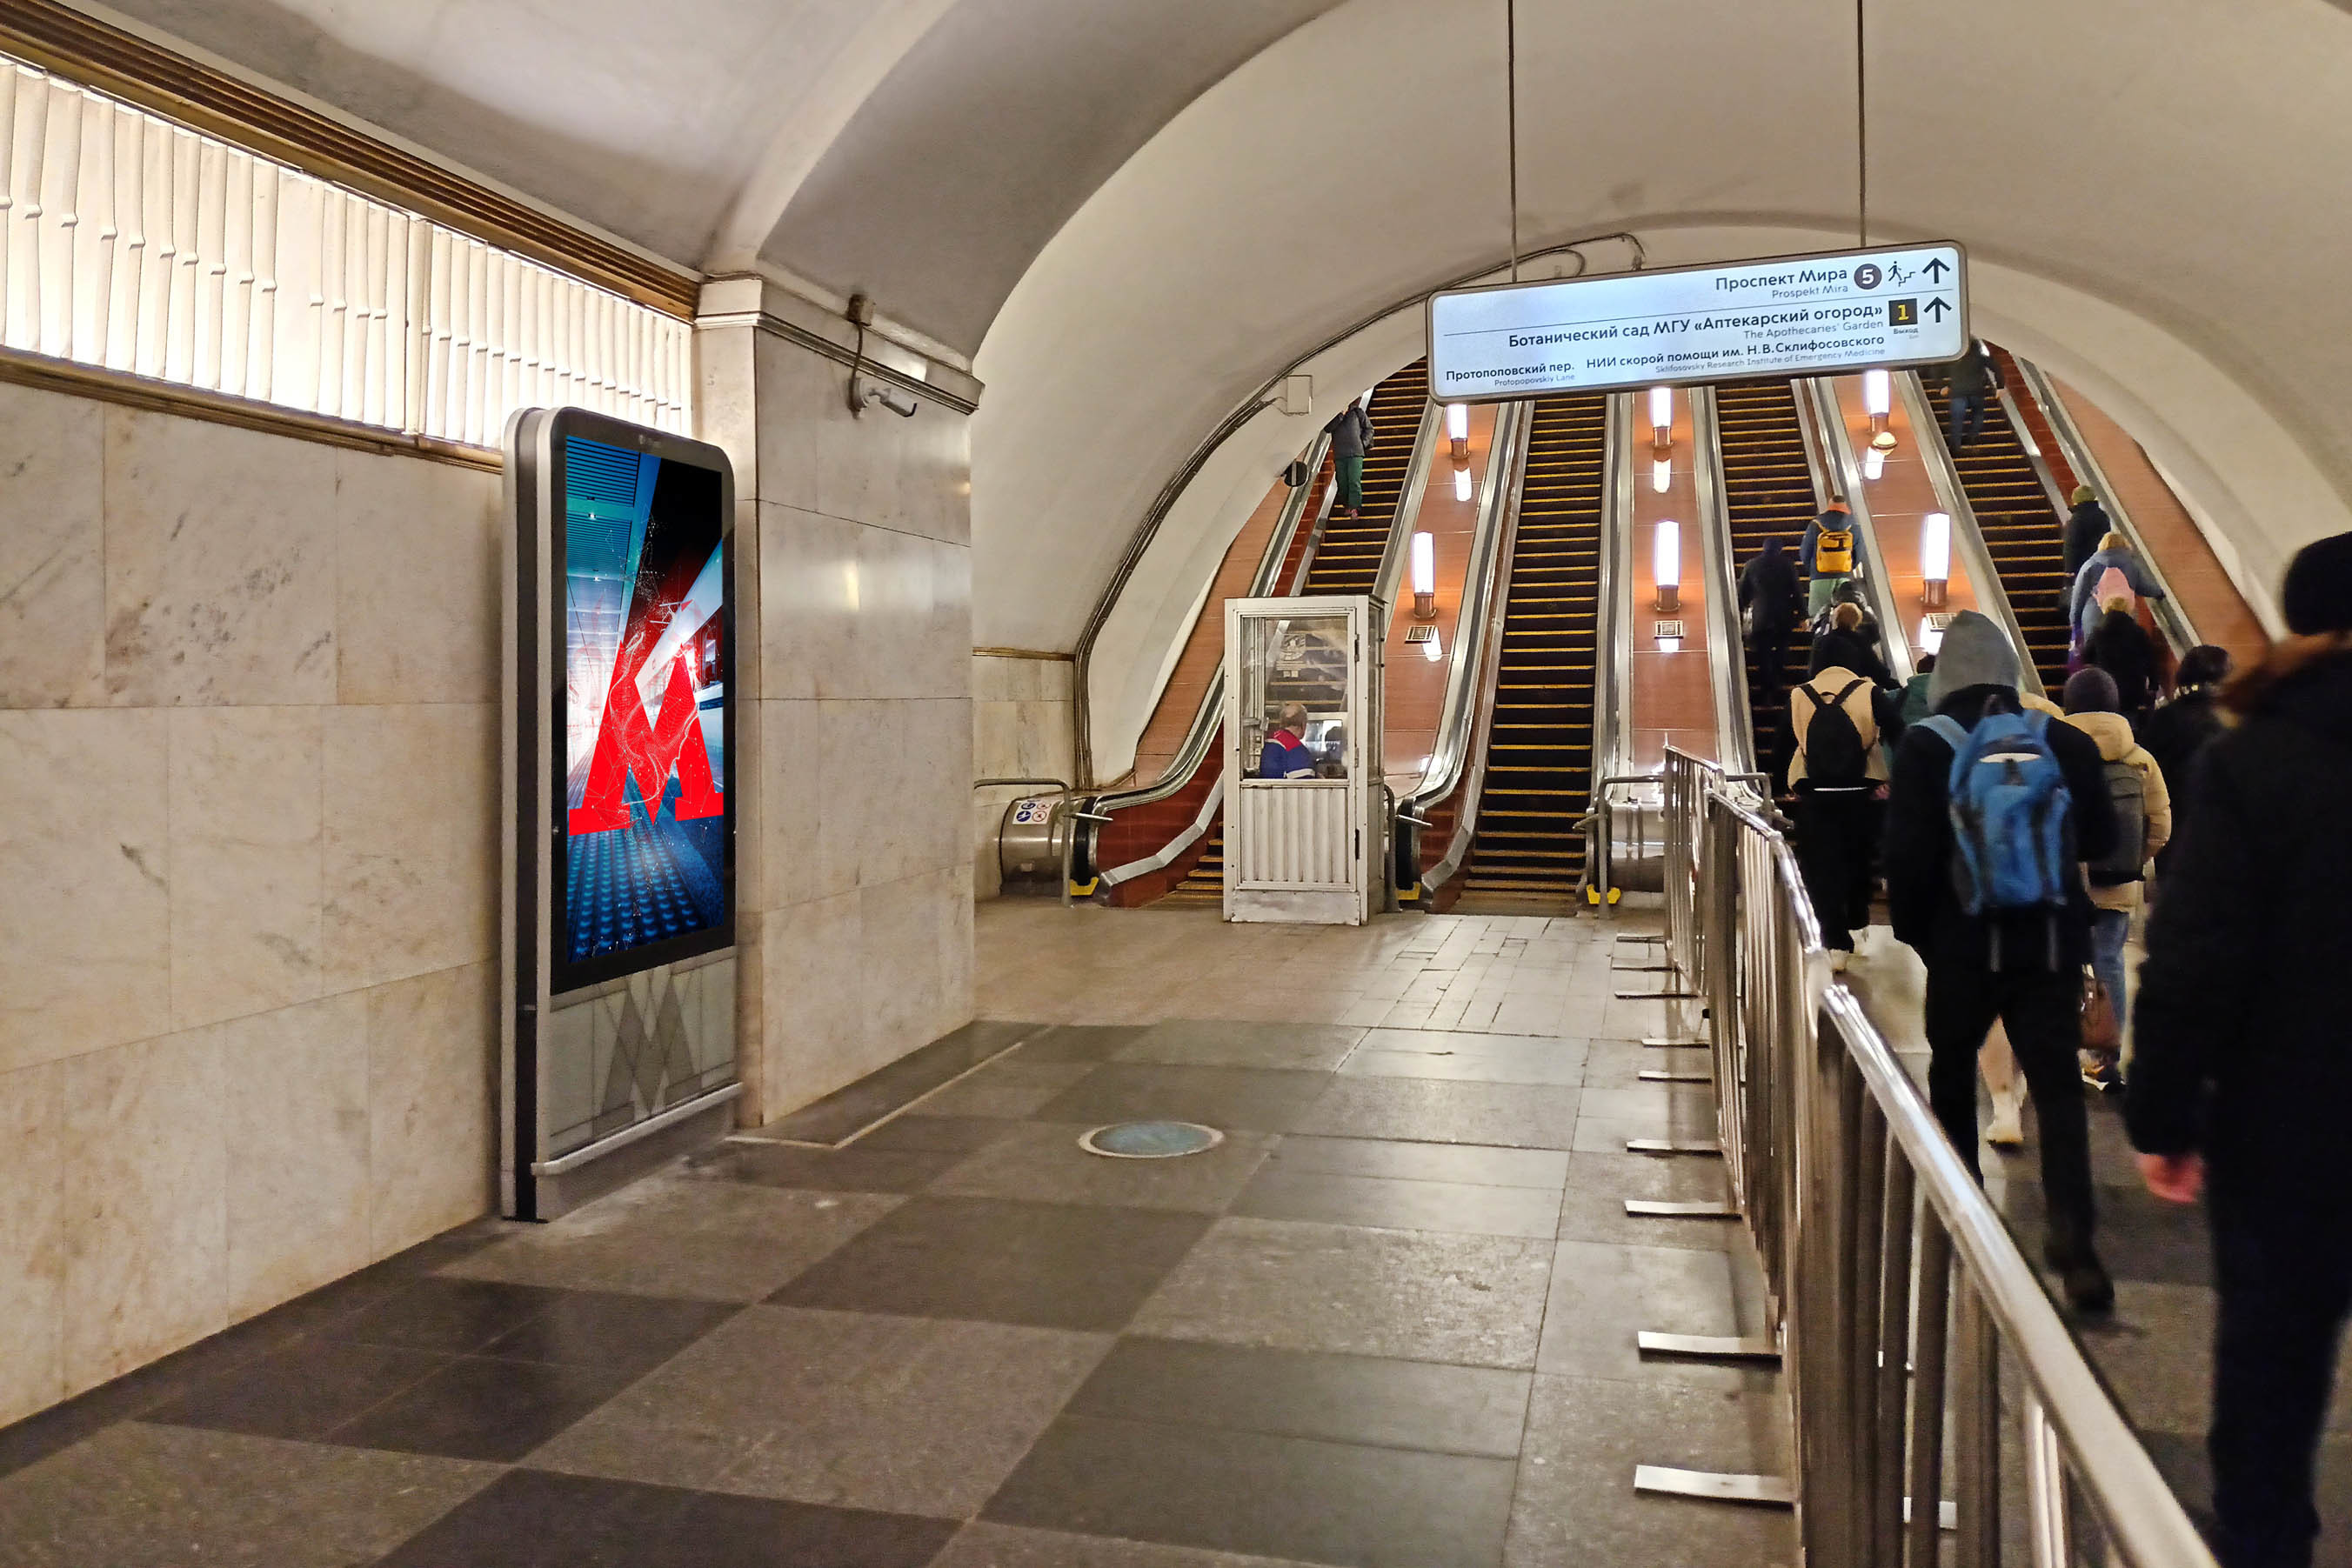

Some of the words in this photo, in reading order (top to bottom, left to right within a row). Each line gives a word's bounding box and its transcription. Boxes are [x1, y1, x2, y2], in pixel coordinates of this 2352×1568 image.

[1715, 274, 1794, 292] Проспект
[1799, 270, 1848, 284] Мира
[1861, 269, 1875, 284] 5
[1772, 288, 1820, 299] Prospekt
[1822, 284, 1848, 294] Mira
[1897, 304, 1910, 321] 1
[1509, 325, 1618, 348] Ботанический
[1622, 325, 1649, 337] сад
[1654, 319, 1691, 335] МГУ
[1694, 309, 1809, 331] «Аптекарский
[1814, 305, 1883, 321] огород»
[1745, 330, 1764, 340] The
[1842, 319, 1884, 331] Garden
[1587, 357, 1616, 369] НИИ
[1620, 353, 1664, 366] скорой
[1667, 349, 1720, 364] помощи
[1722, 348, 1744, 358] им.
[1655, 363, 1705, 374] Sklifosovsky
[1707, 359, 1745, 370] Research
[1747, 356, 1782, 366] Institute
[1784, 354, 1793, 363] of
[1795, 350, 1842, 363] Emergency
[1845, 348, 1885, 357] Medicine
[1446, 364, 1546, 383] Протопоповский
[1549, 362, 1575, 374] пер.
[1494, 375, 1554, 387] Protopopovskiy
[1556, 373, 1575, 382] Lane
